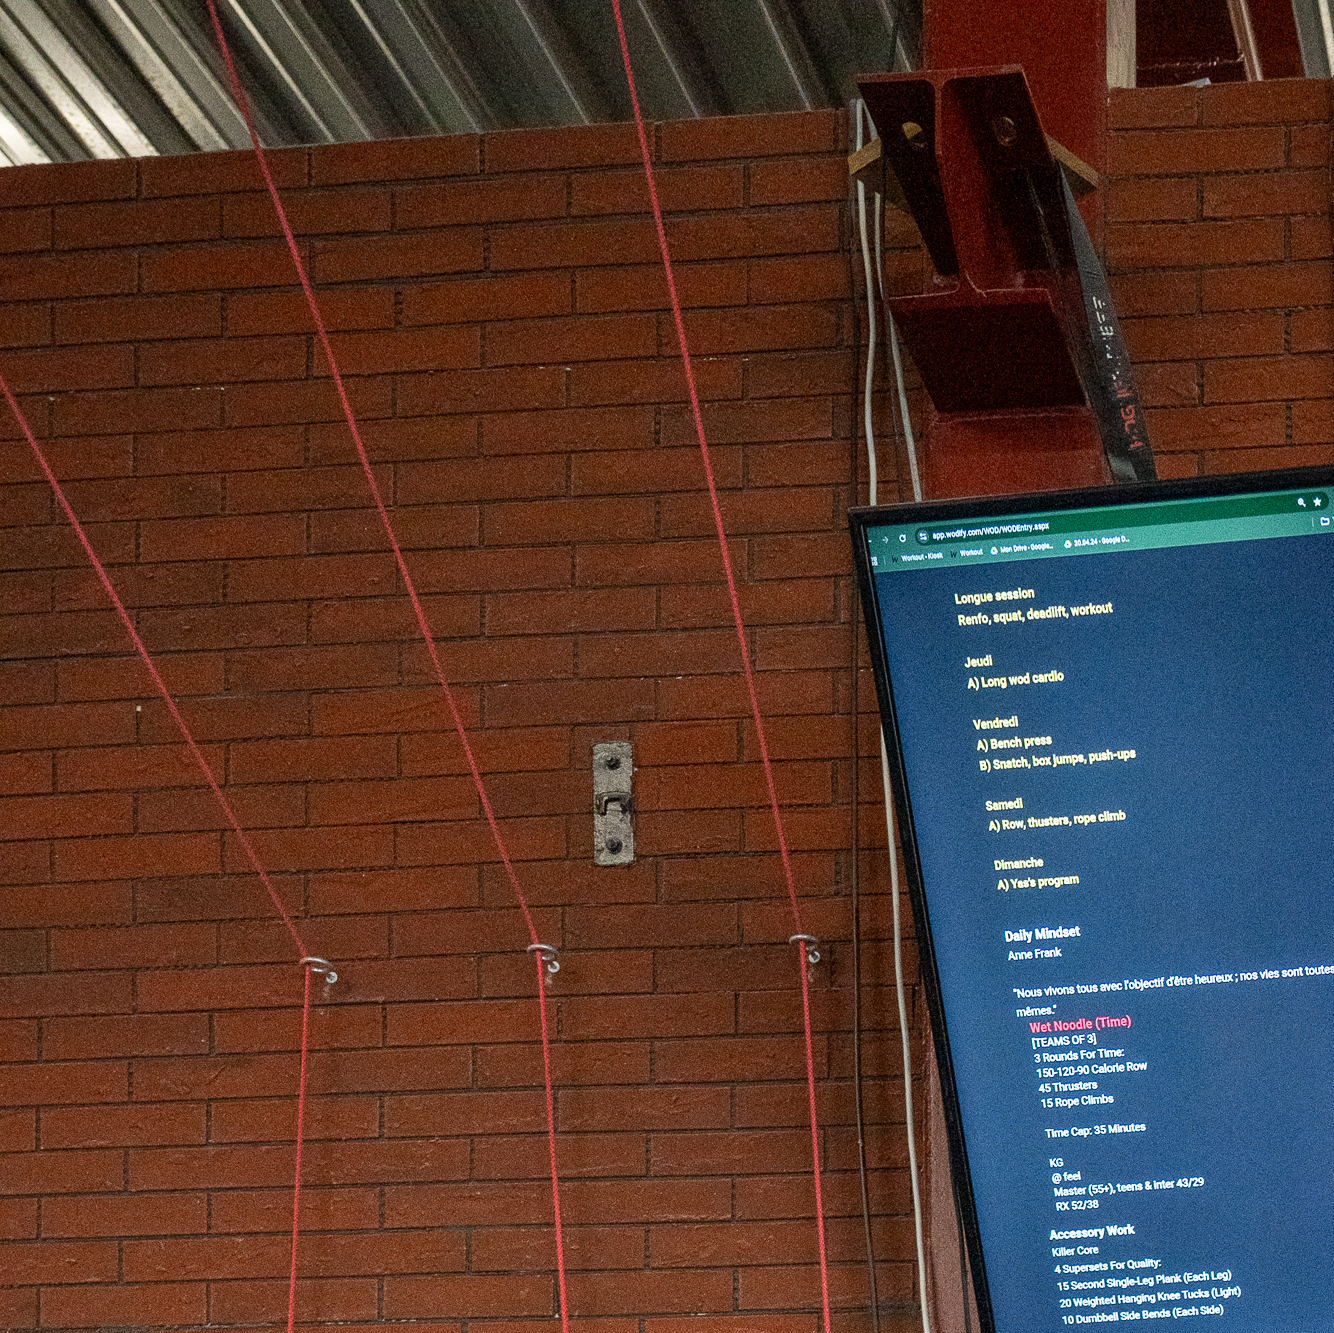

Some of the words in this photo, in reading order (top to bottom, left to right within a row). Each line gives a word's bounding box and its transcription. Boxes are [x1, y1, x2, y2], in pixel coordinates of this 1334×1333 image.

[932, 524, 1050, 541] app.wodify.com/WOD/WODEntry.aspx
[955, 593, 993, 605] Longue
[995, 587, 1035, 601] session
[958, 612, 991, 626] Renfo,
[993, 610, 1025, 624] squat,
[1027, 605, 1069, 619] deadlift,
[1070, 602, 1113, 616] workout
[964, 654, 992, 668] Jeudi
[968, 677, 979, 690] A)
[981, 677, 1007, 688] Long
[1009, 672, 1030, 685] wod
[1032, 670, 1064, 683] cardio
[973, 716, 1018, 730] Vendredi
[977, 739, 988, 752] A)
[990, 736, 1022, 749] Bench
[1024, 736, 1052, 749] press
[979, 759, 991, 772] B)
[993, 757, 1031, 769] Snatch,
[1032, 756, 1051, 766] box
[1053, 754, 1087, 767] jumps,
[1088, 749, 1136, 764] push-ups
[986, 798, 1023, 811] Samedi
[994, 857, 1043, 870] Dimanche
[998, 879, 1009, 891] A)
[1010, 877, 1036, 888] Yas's
[1038, 876, 1079, 889] program
[1005, 929, 1033, 943] Daily
[1035, 926, 1081, 940] Mindset
[1008, 951, 1033, 961] Anne
[1035, 947, 1062, 958] Frank
[1013, 988, 1043, 998] "Nous
[1044, 986, 1075, 996] vivons
[1076, 984, 1098, 994] tous
[1100, 983, 1123, 992] avec
[1124, 977, 1165, 991] l'objectif
[1166, 976, 1193, 987] d'être
[1195, 974, 1234, 985] heureux
[1240, 972, 1258, 981] nos
[1259, 969, 1280, 979] vies
[1282, 967, 1304, 978] sont
[1029, 1022, 1053, 1033] Wet
[1053, 1018, 1093, 1031] Noodle
[1094, 1015, 1132, 1031] (Time)
[1032, 1036, 1070, 1050] [TEAMS
[1072, 1034, 1085, 1044] OF
[1087, 1033, 1097, 1045] 3]
[1037, 1065, 1090, 1078] 150-120-90
[1091, 1063, 1125, 1074] Calorie
[1126, 1062, 1147, 1071] Row
[1039, 1083, 1051, 1093] 45
[1052, 1081, 1098, 1092] Thrusters
[1041, 1098, 1053, 1108] 15
[1055, 1098, 1080, 1109] Rope
[1081, 1094, 1114, 1105] Climbs
[1045, 1129, 1069, 1138] Time
[1071, 1127, 1092, 1138] Cap:
[1094, 1125, 1107, 1134] 35
[1108, 1123, 1146, 1133] Minutes
[1049, 1158, 1064, 1167] KG
[1063, 1171, 1081, 1181] feel
[1056, 1201, 1070, 1211] RX
[1072, 1199, 1099, 1210] 52/38
[1050, 1228, 1105, 1240] Accessory
[1106, 1224, 1135, 1236] Work
[1052, 1247, 1075, 1257] Killer
[1077, 1246, 1099, 1255] Core
[1055, 1265, 1061, 1274] 4
[1062, 1262, 1108, 1275] Supersets
[1110, 1261, 1126, 1270] For
[1127, 1259, 1161, 1270] Quality:
[1059, 1299, 1072, 1308] 20
[1073, 1295, 1116, 1308] Weighted
[1117, 1294, 1156, 1305] Hanging
[1157, 1292, 1181, 1301] Knee
[1181, 1289, 1210, 1299] Tucks
[1211, 1286, 1241, 1299] (Light)
